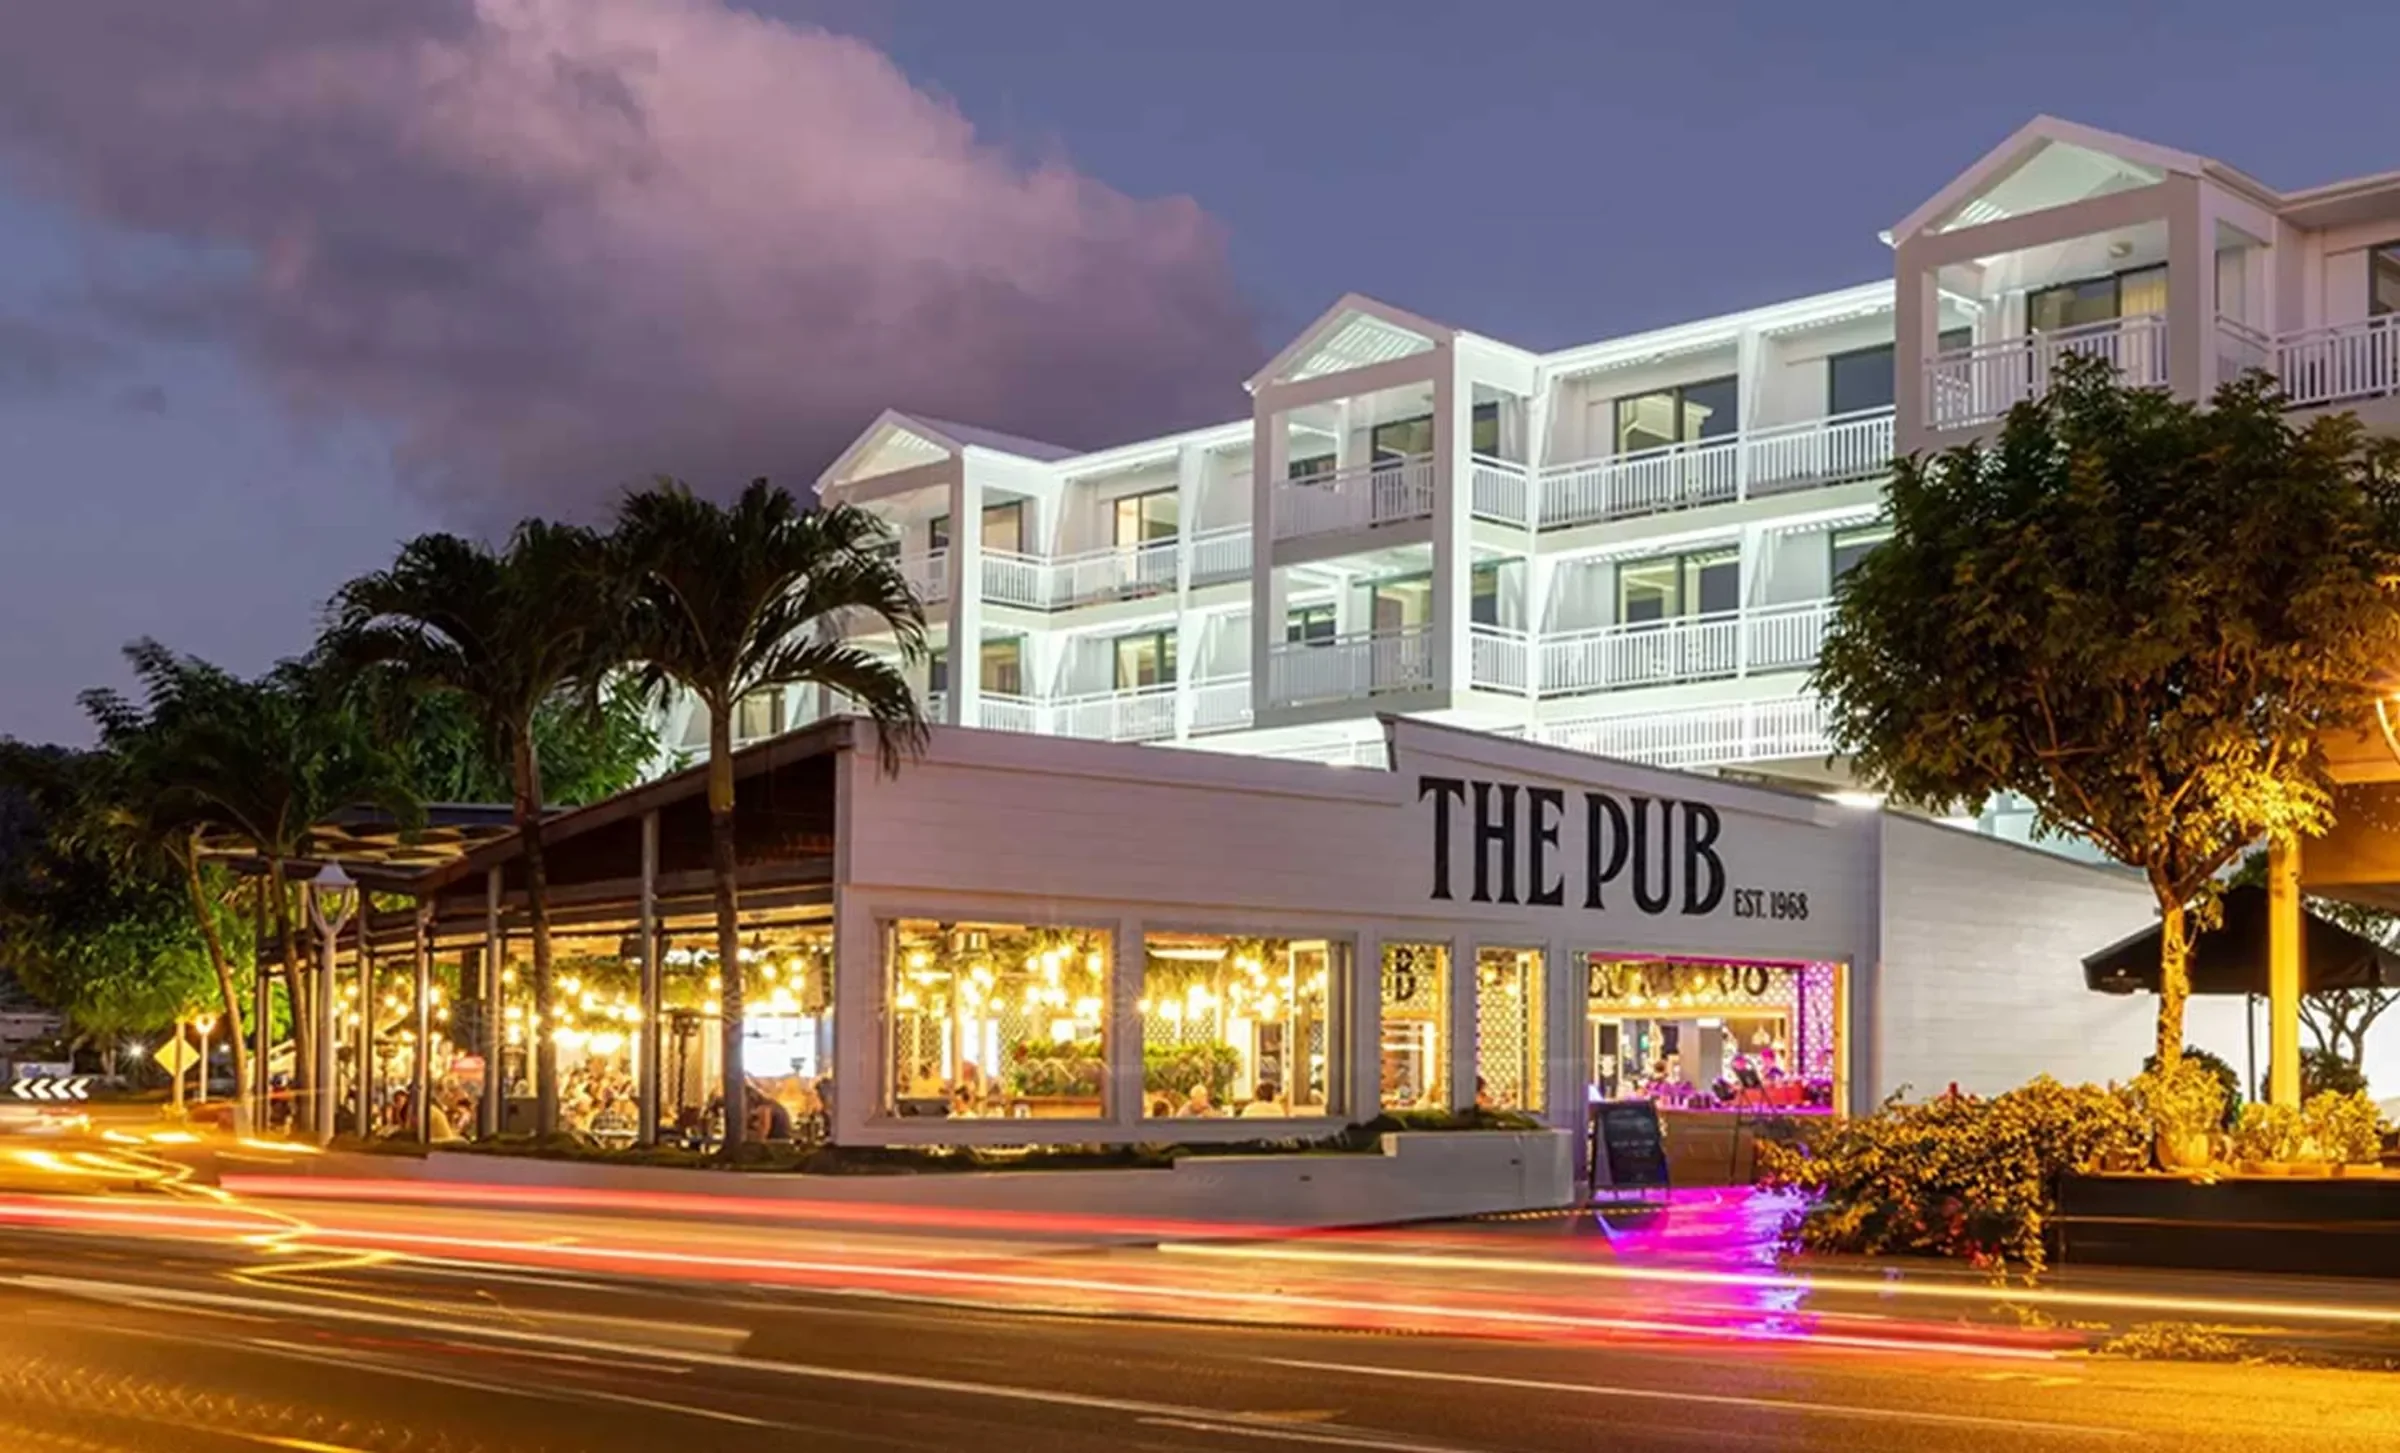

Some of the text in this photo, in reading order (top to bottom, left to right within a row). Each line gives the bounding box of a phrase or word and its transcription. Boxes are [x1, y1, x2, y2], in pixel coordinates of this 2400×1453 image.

[1418, 776, 1726, 916] THE PUB
[1734, 888, 1809, 921] EST. 1968
